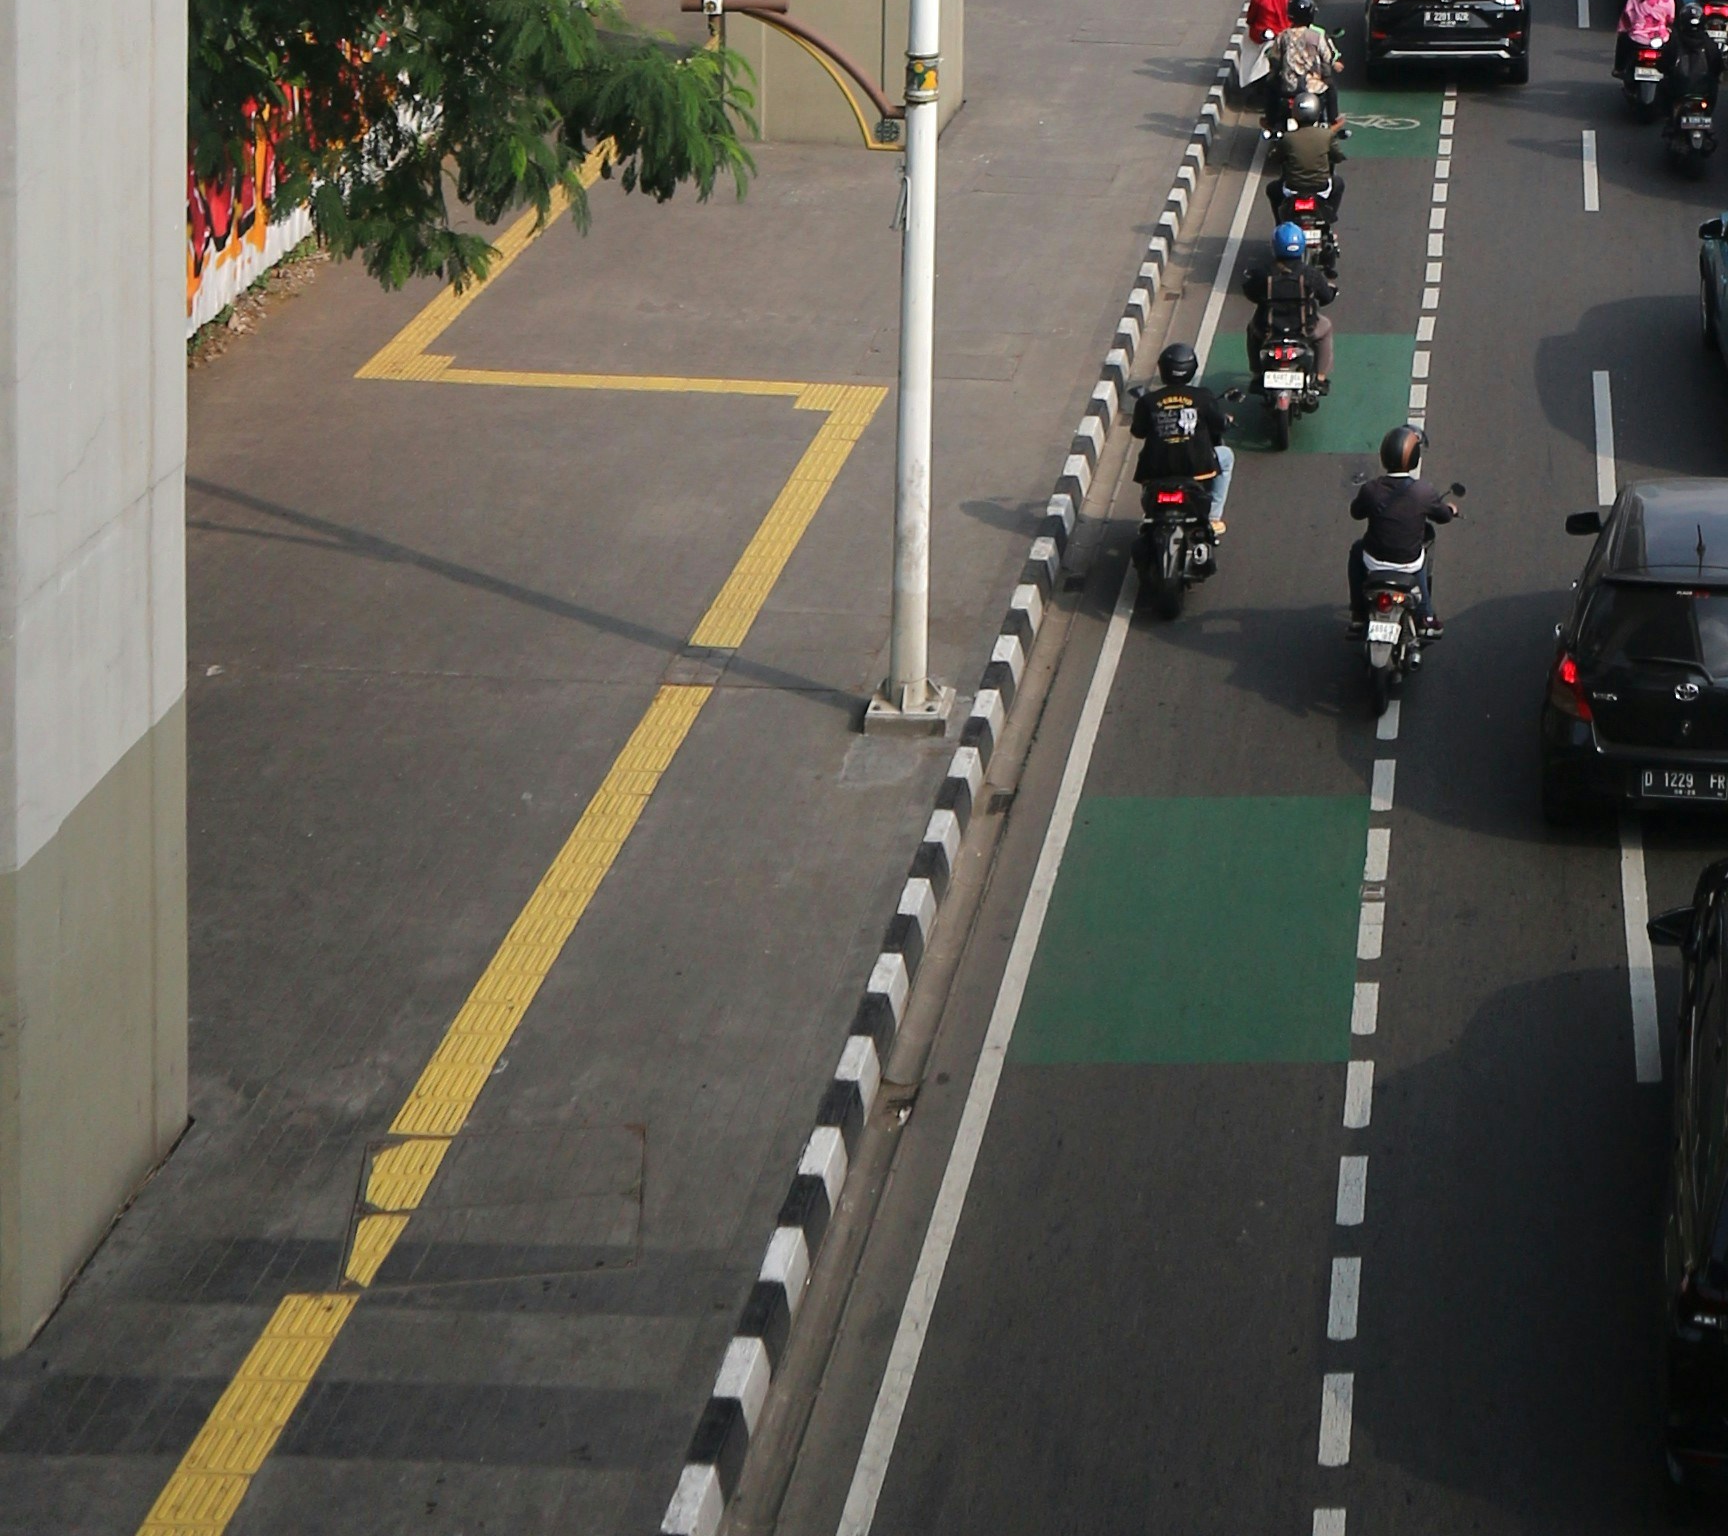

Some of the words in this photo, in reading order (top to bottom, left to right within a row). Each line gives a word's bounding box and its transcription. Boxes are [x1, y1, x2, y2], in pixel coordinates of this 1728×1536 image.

[1645, 771, 1653, 786] D
[1664, 772, 1694, 788] 1229
[1709, 774, 1726, 790] FR
